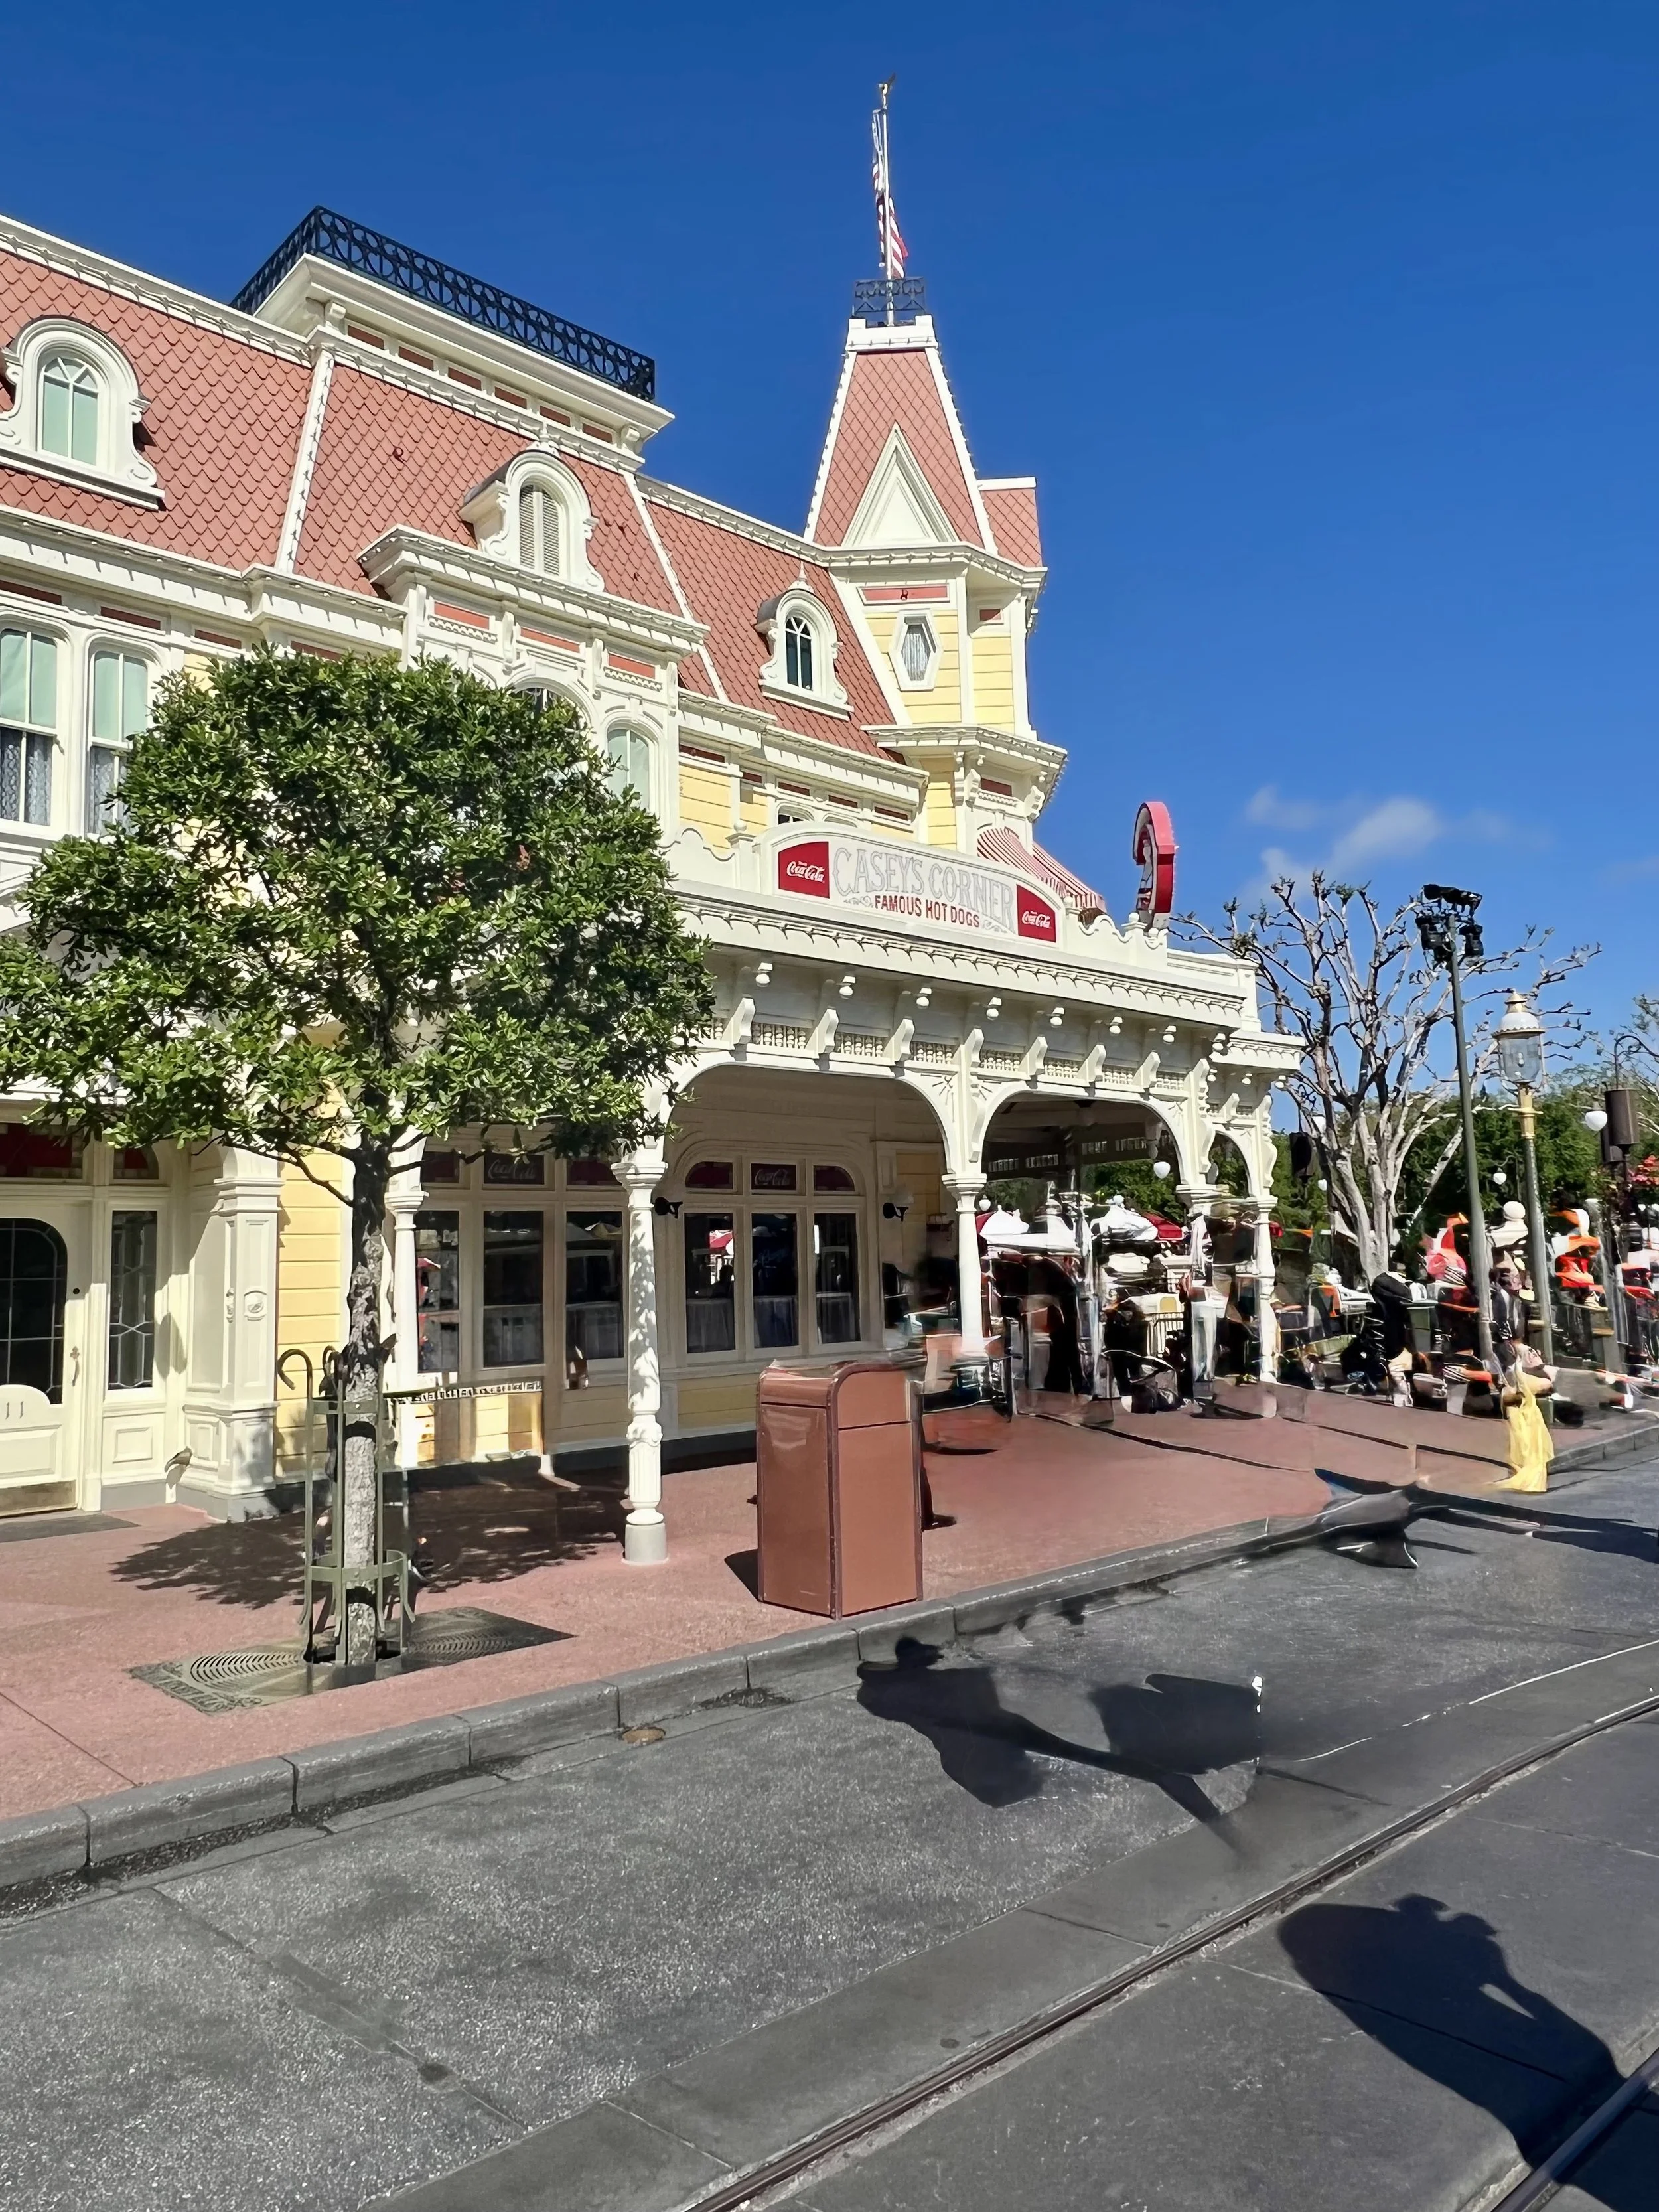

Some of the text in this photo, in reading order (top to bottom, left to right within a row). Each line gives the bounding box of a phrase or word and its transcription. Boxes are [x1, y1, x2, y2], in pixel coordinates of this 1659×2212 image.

[833, 847, 1016, 934] CASEY'S CORNER
[875, 895, 980, 928] FAMOUS HOT DOGS
